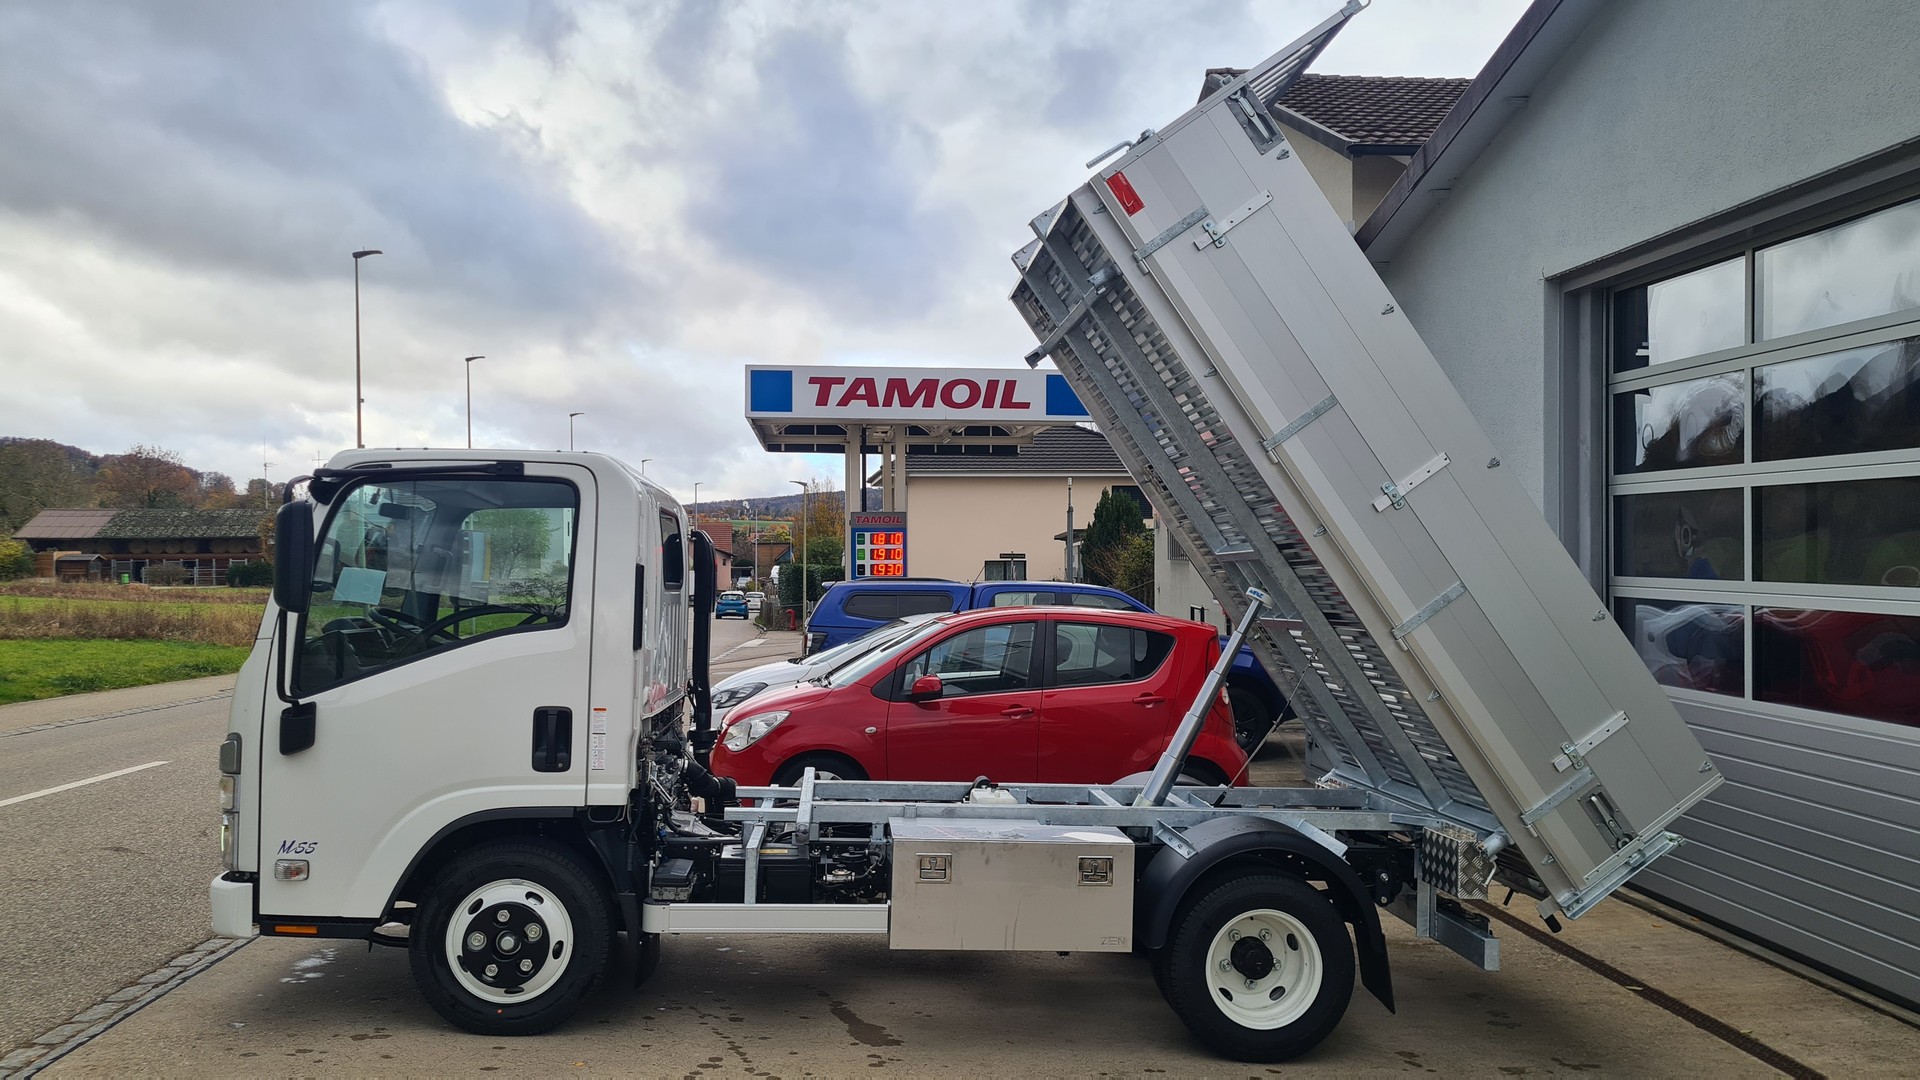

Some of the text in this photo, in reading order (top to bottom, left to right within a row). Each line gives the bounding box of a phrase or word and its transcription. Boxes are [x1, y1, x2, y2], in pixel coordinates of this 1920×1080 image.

[808, 376, 1031, 410] TAMOIL
[855, 515, 903, 524] TAMOIL
[873, 533, 903, 545] 1.810
[873, 548, 903, 560] 1.910
[873, 563, 903, 575] 1.930
